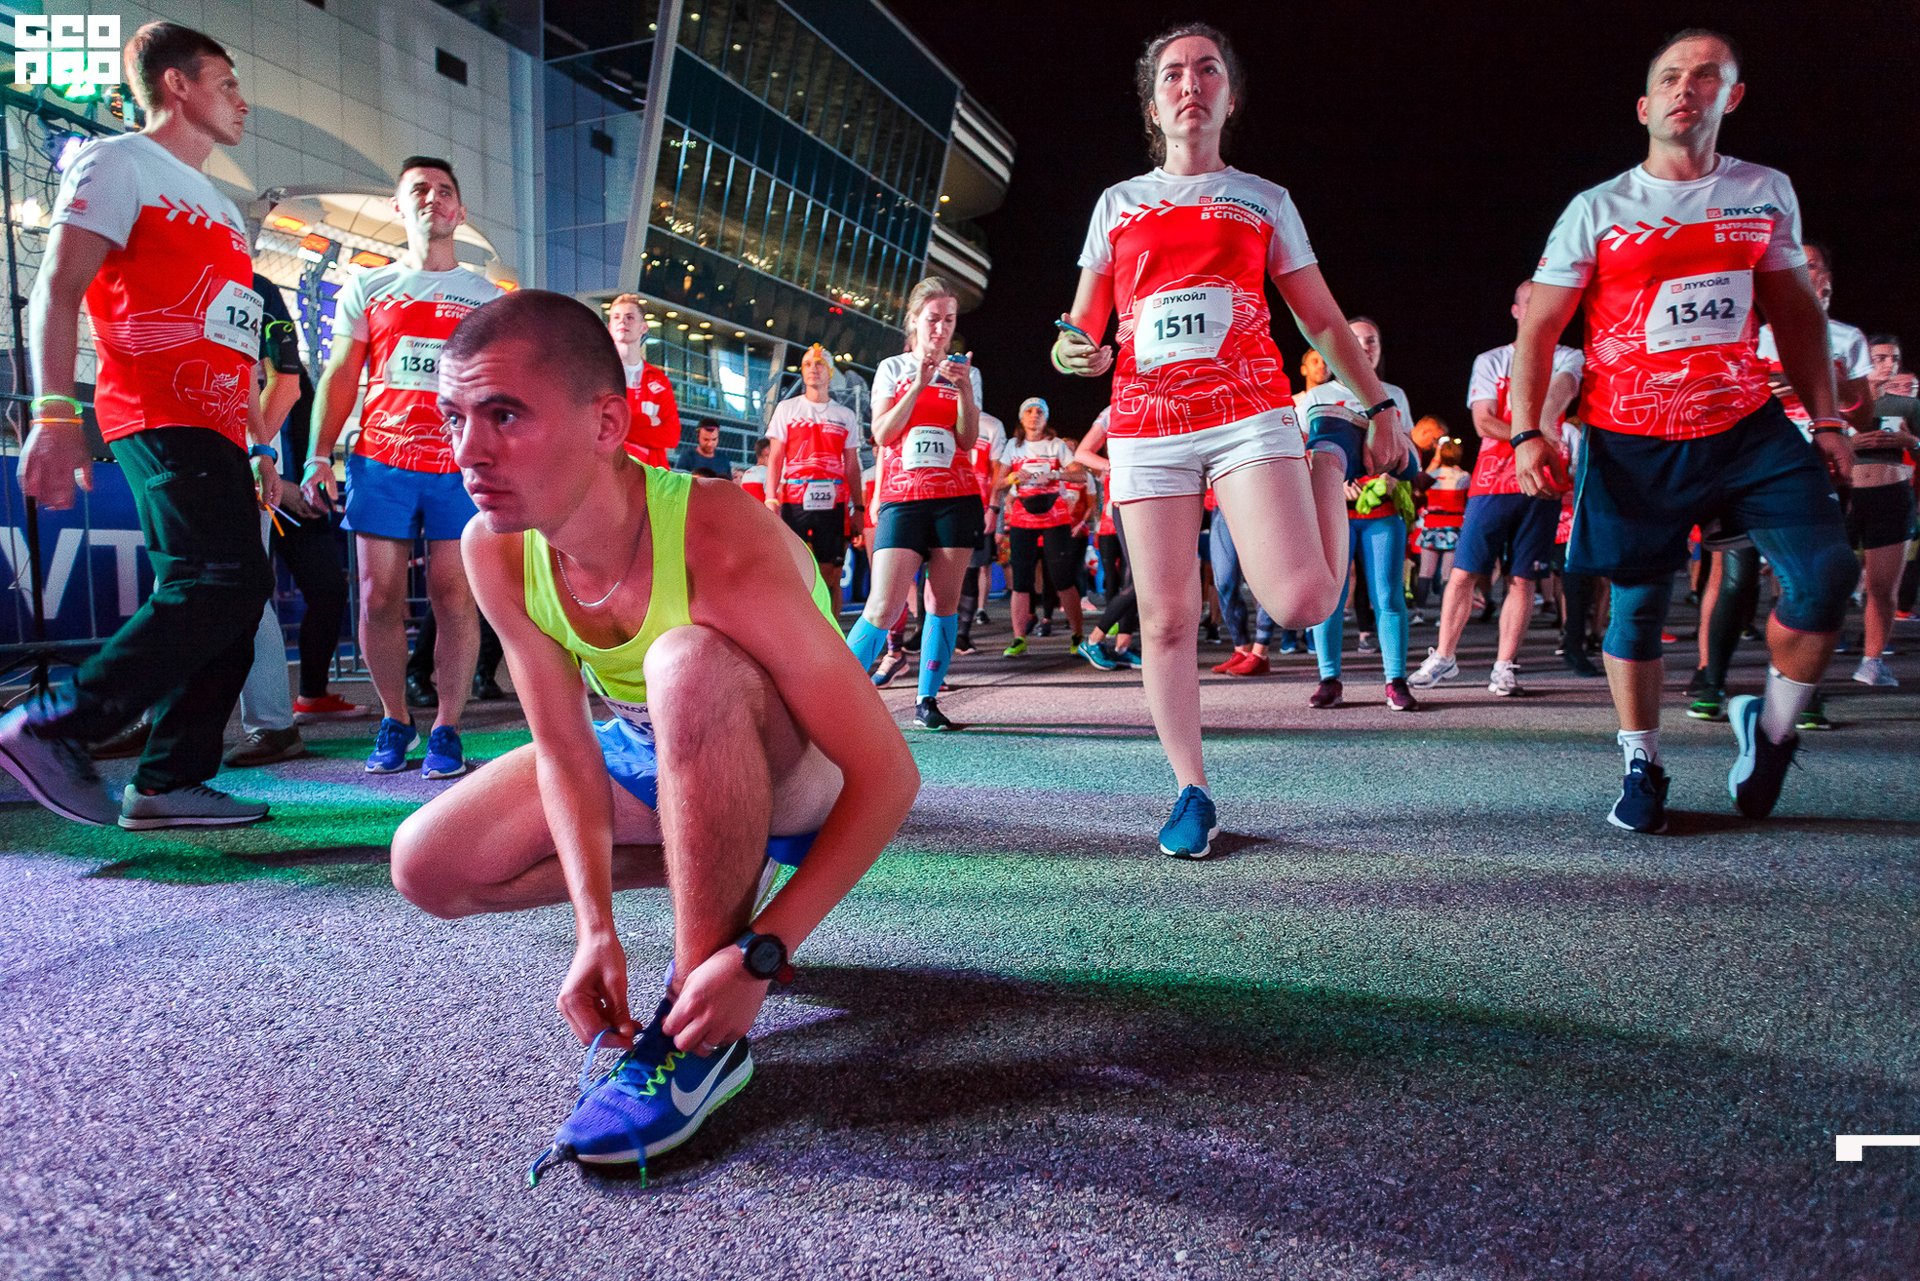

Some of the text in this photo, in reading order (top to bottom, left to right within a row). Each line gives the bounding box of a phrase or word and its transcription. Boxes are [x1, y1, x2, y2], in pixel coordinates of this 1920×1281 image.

[1200, 211, 1211, 220] В
[1714, 232, 1726, 243] В
[1683, 277, 1730, 291] ЛУКОЙЛ
[1162, 291, 1207, 305] ЛУКОЙЛ
[1666, 297, 1736, 325] 1342
[226, 305, 263, 338] 124
[1154, 313, 1206, 341] 1511
[401, 355, 441, 375] 138
[915, 441, 945, 454] 1711
[810, 492, 832, 501] 1225
